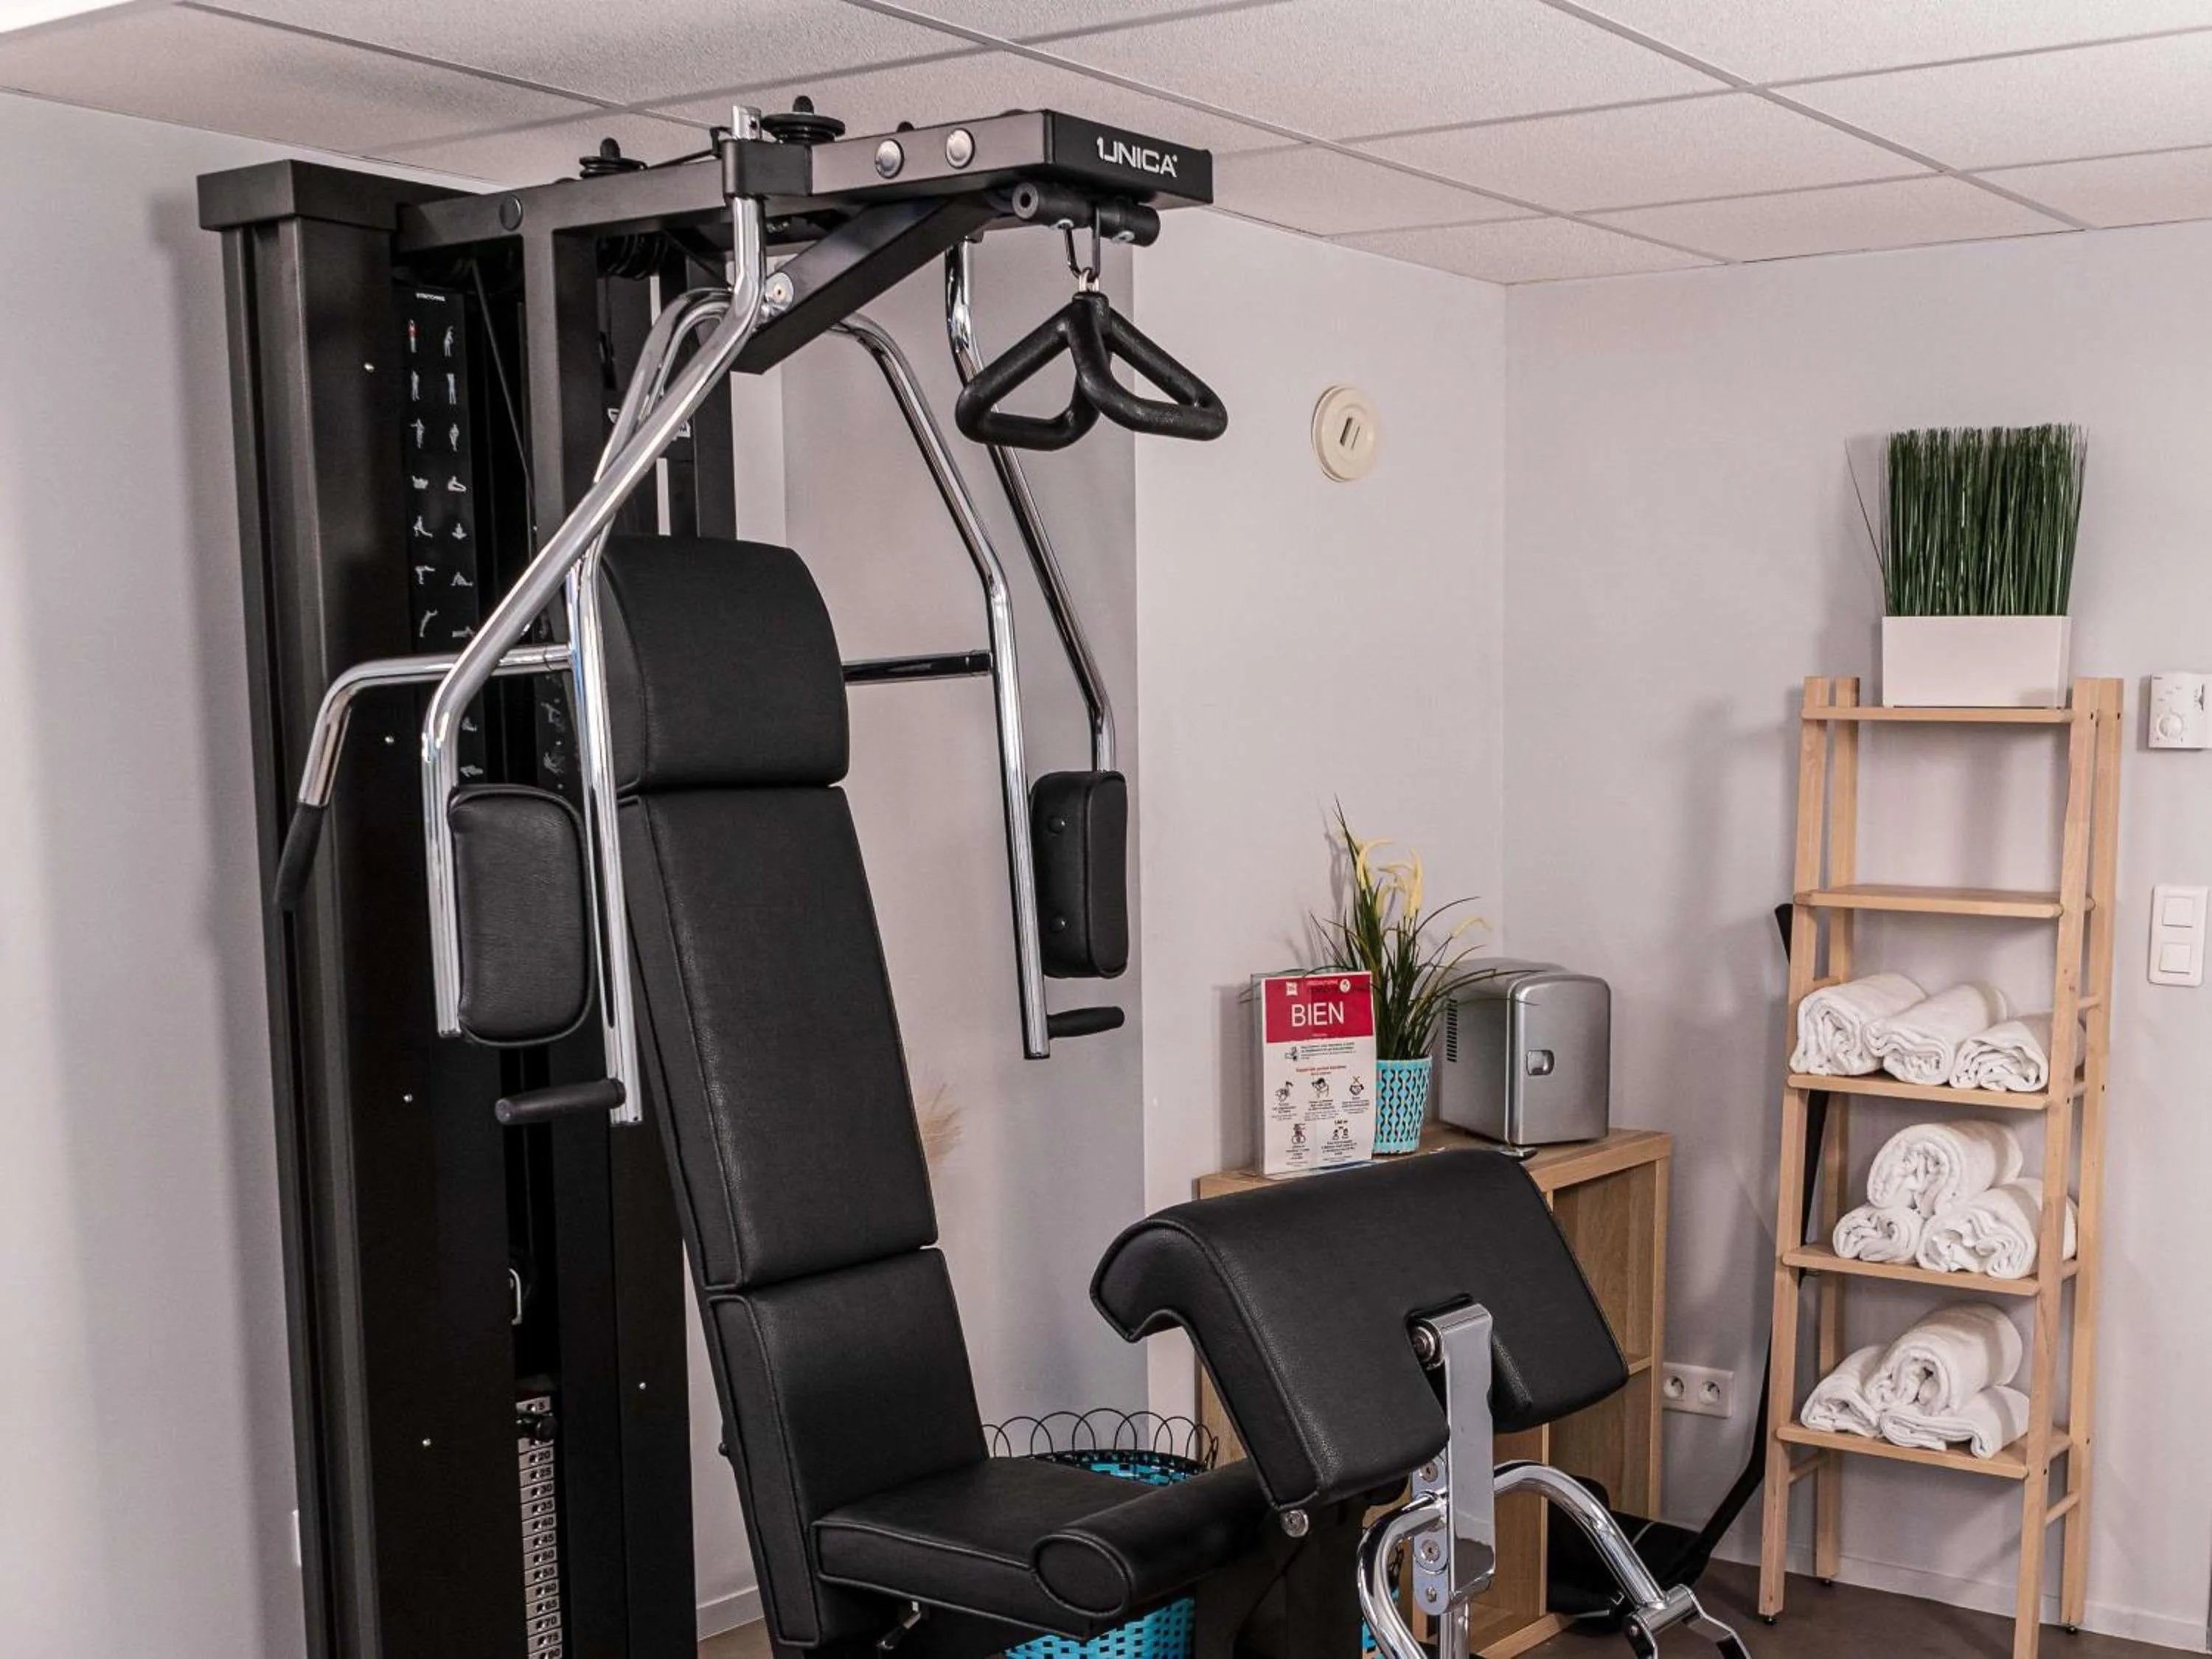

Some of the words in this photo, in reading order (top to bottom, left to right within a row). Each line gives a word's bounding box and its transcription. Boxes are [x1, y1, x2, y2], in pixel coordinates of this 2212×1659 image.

[1291, 1001, 1344, 1027] BIEN
[538, 1451, 550, 1461] 20
[540, 1467, 552, 1478] 25
[540, 1484, 552, 1494] 30
[542, 1500, 553, 1511] 35
[542, 1517, 554, 1526] 40
[542, 1533, 554, 1543] 45
[542, 1550, 554, 1560] 50
[545, 1600, 557, 1610] 65
[546, 1616, 557, 1627] 70
[547, 1633, 558, 1644] 75
